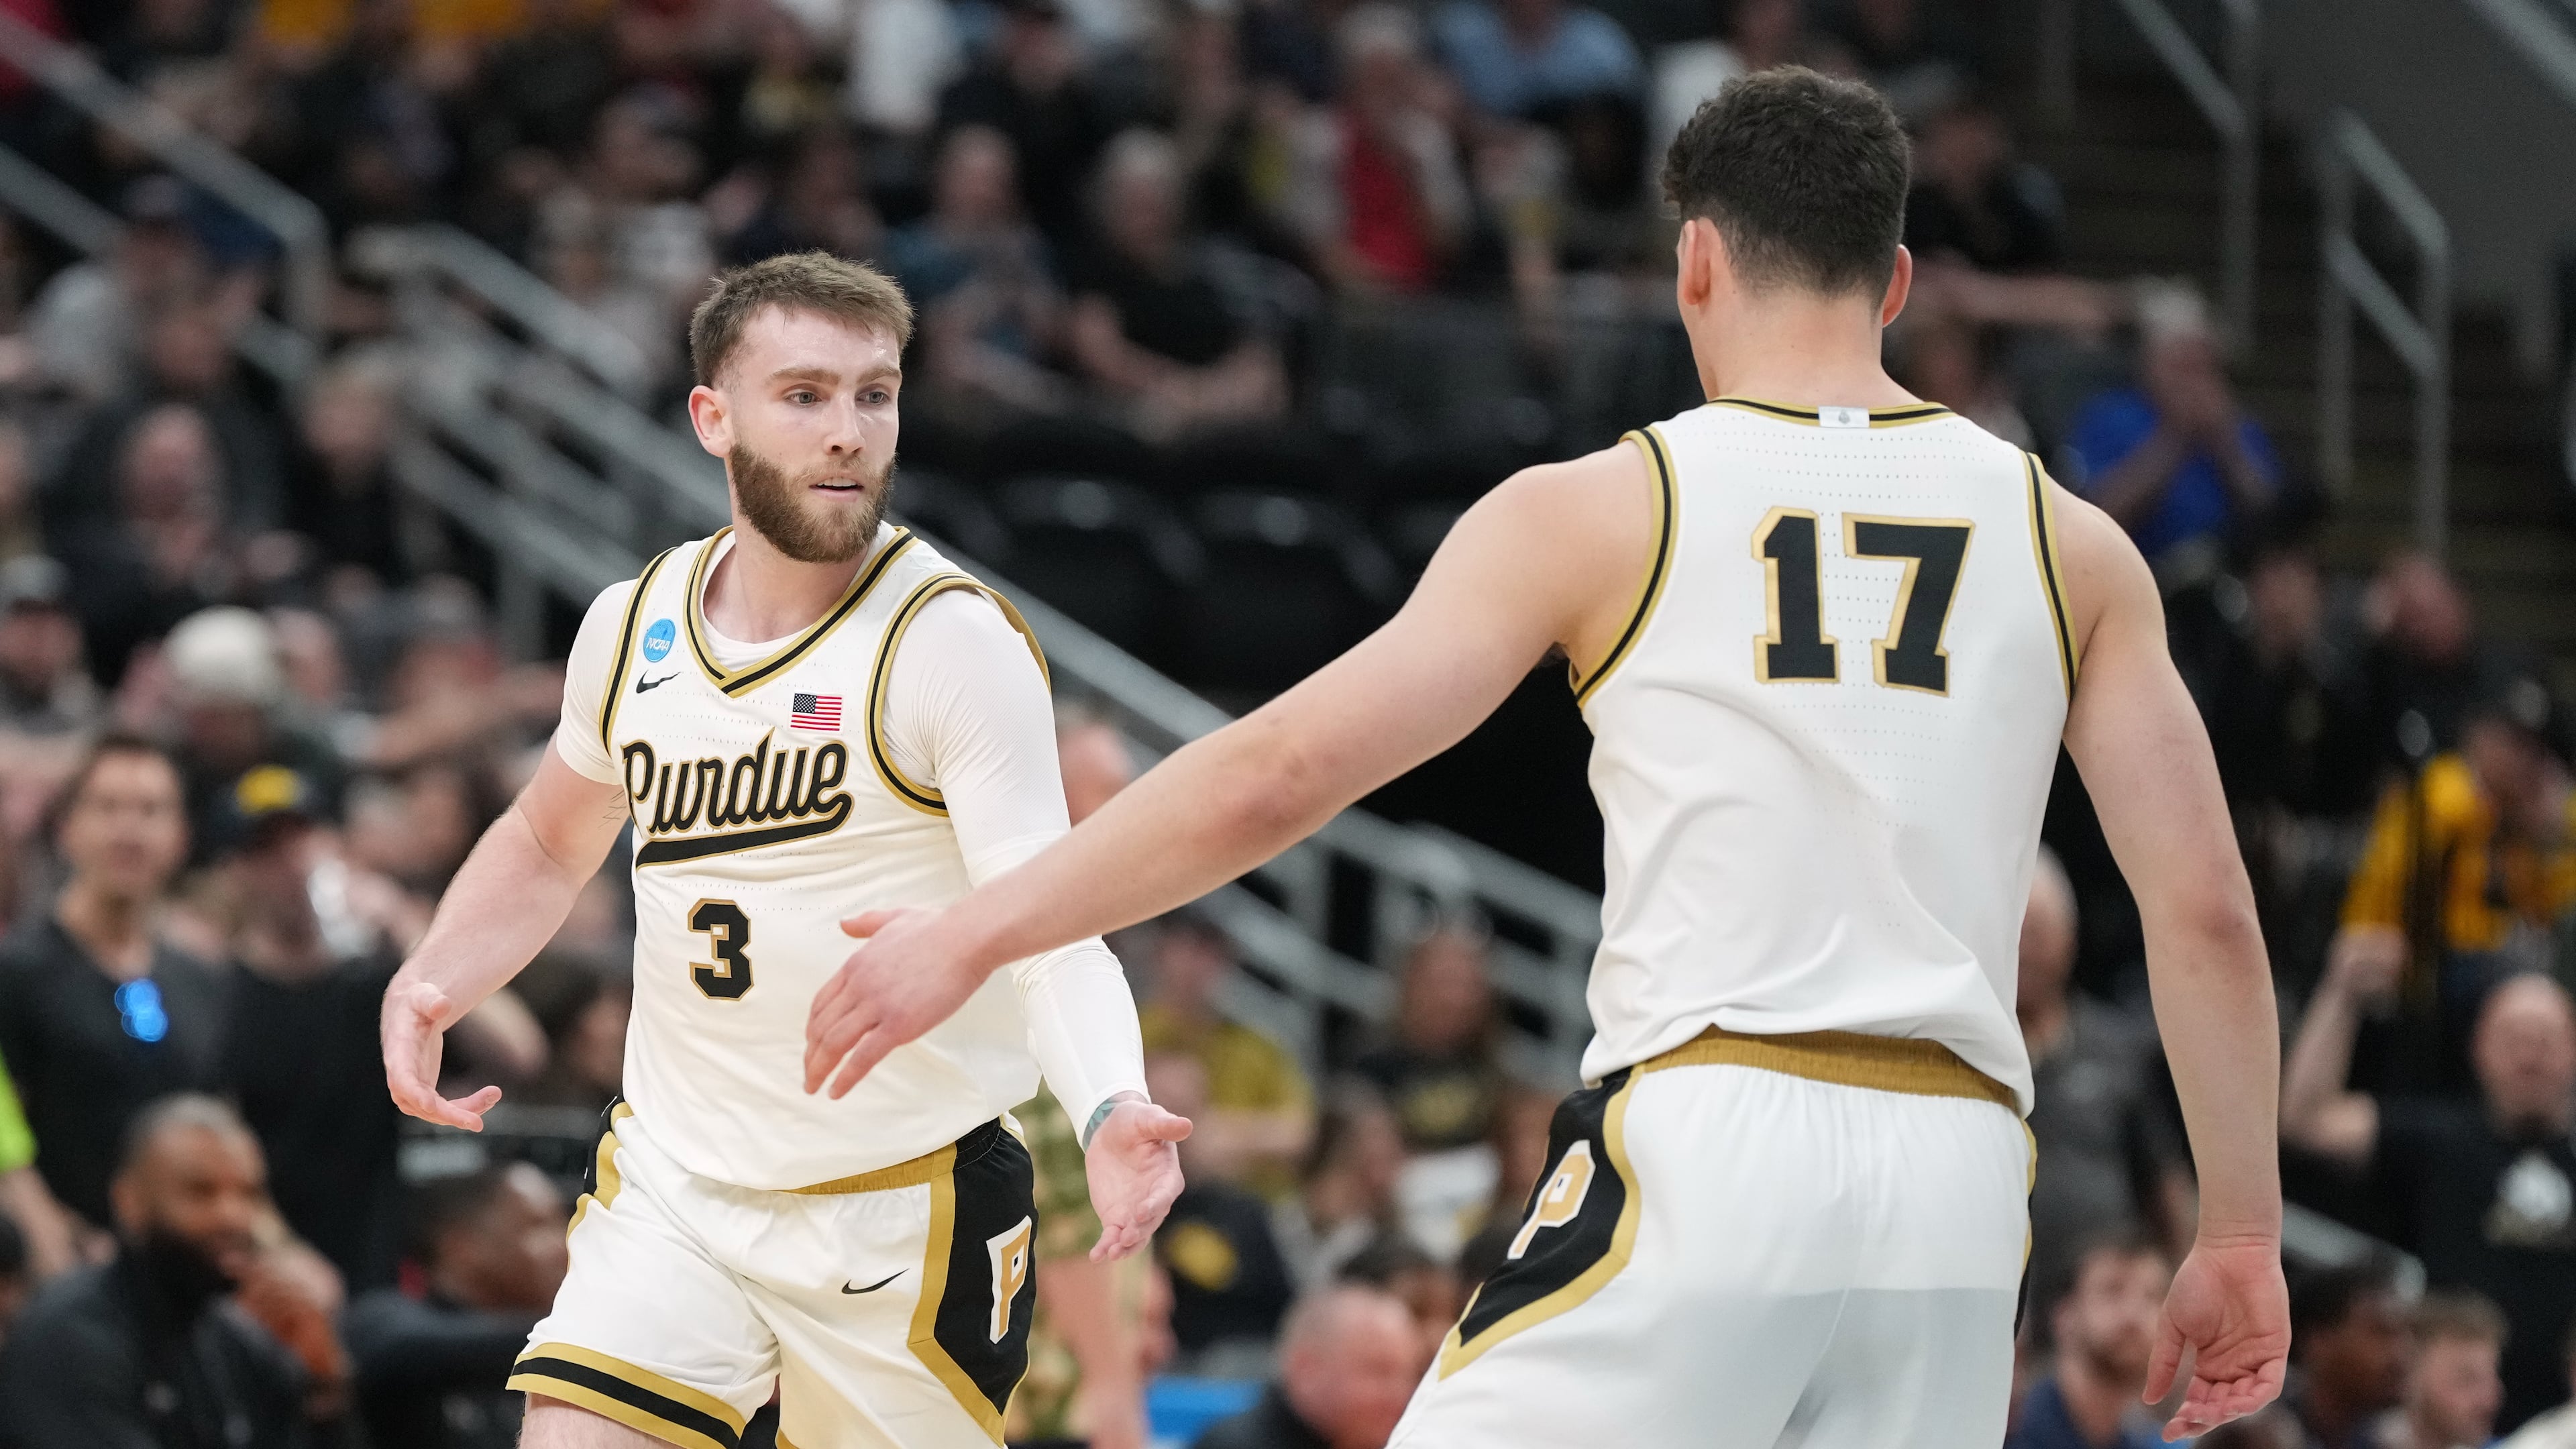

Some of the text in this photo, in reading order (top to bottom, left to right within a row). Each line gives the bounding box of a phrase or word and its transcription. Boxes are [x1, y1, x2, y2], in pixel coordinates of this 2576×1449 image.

[645, 637, 671, 651] NCAA
[1750, 505, 1976, 698] 17
[621, 726, 855, 841] Purdue
[688, 898, 755, 1000] 3
[1507, 1139, 1597, 1260] P
[985, 1214, 1032, 1344] P
